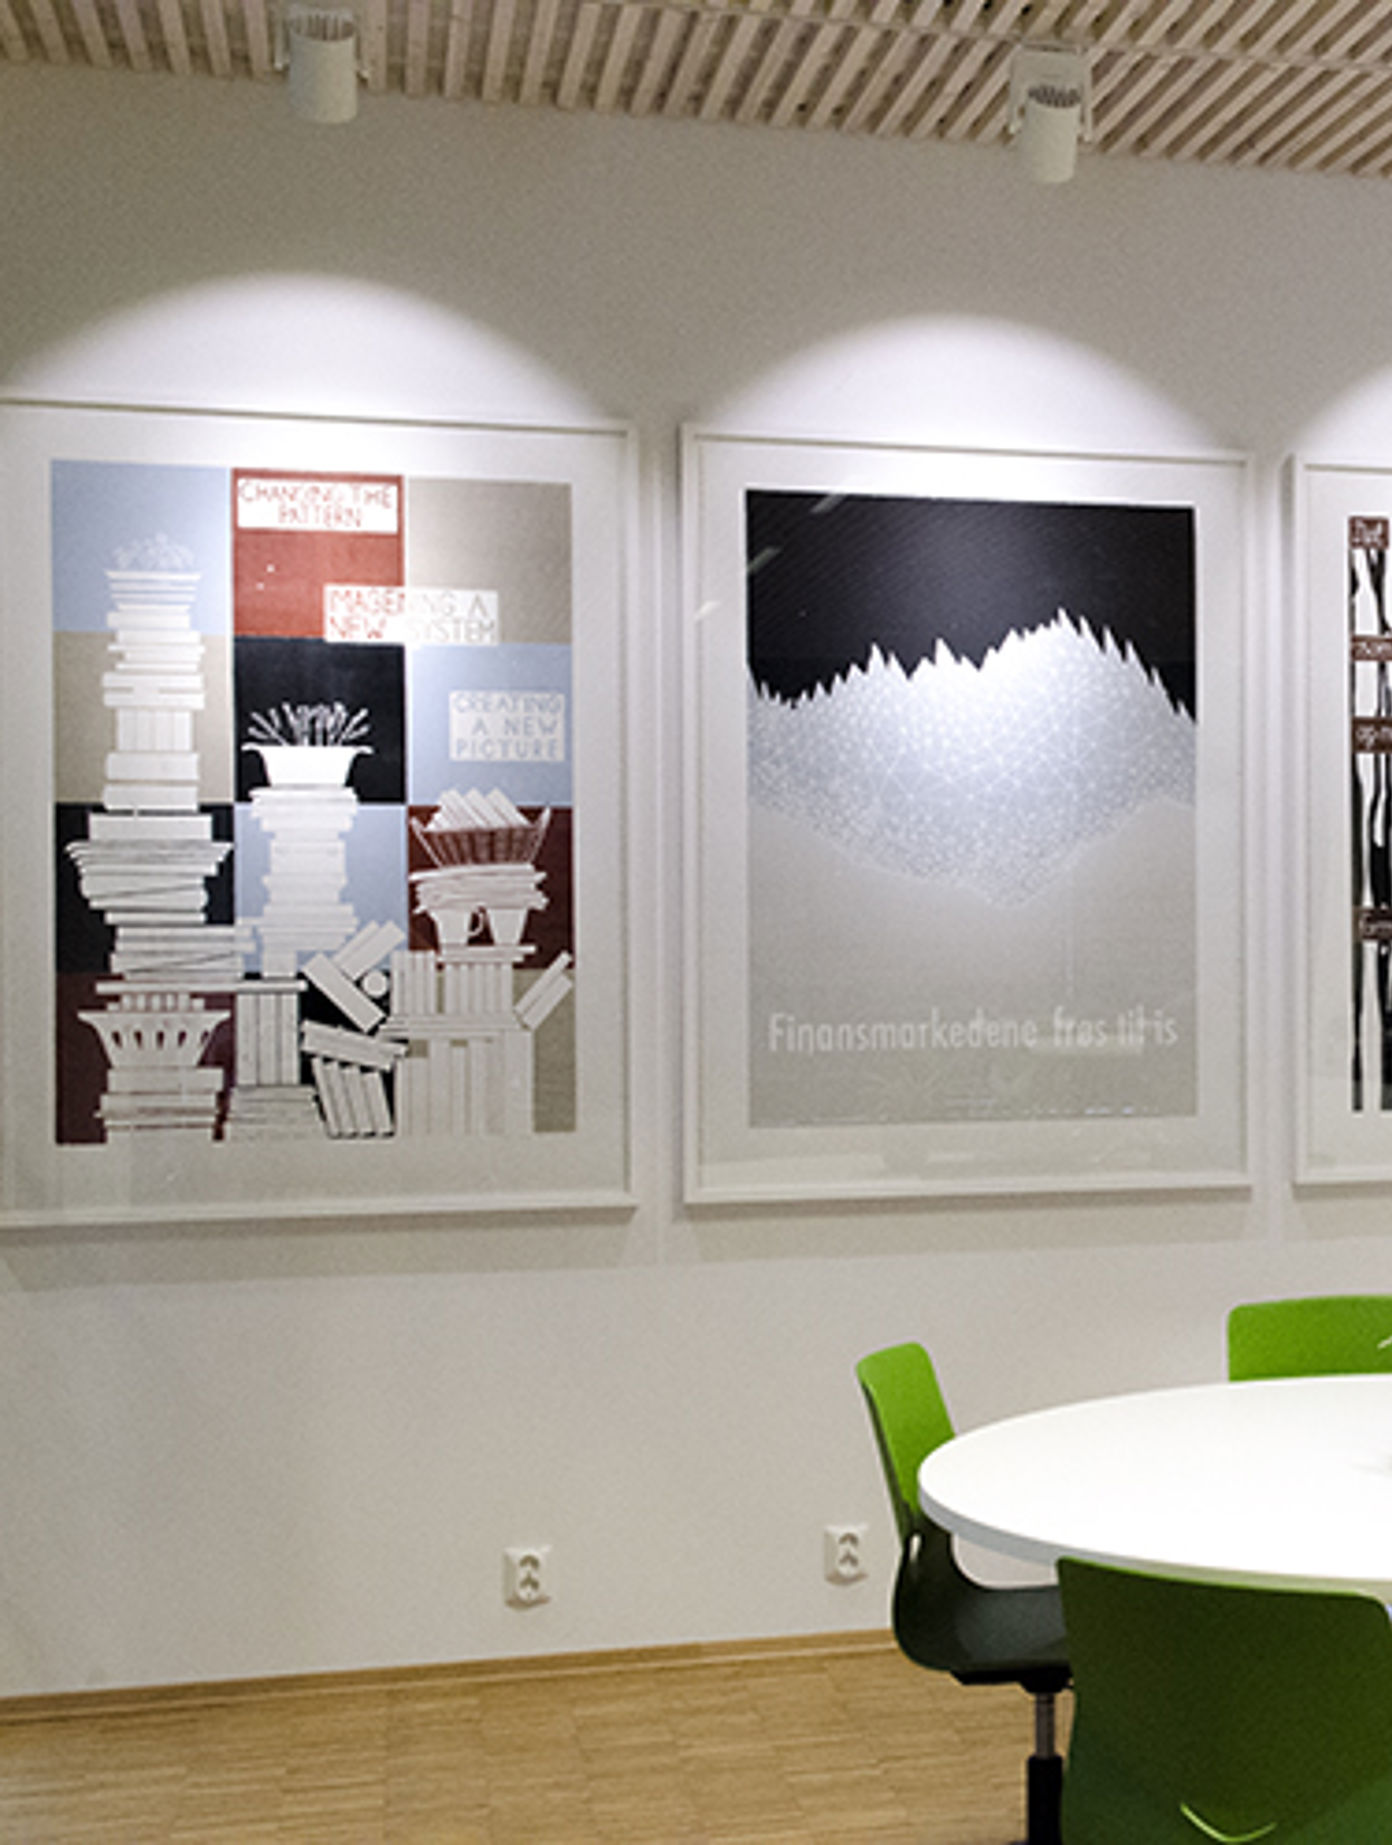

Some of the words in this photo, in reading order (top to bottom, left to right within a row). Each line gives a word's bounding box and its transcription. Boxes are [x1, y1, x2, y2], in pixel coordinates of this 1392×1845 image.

[352, 484, 392, 509] THE
[277, 503, 364, 528] PATTERN
[468, 592, 490, 620] A
[330, 615, 388, 639] NEW
[455, 692, 562, 714] CREATING
[471, 717, 489, 736] A
[503, 716, 558, 736] NEW
[456, 737, 558, 759] PICTURE
[768, 1006, 1039, 1053] Finansmarkedene
[1154, 1008, 1179, 1046] is
